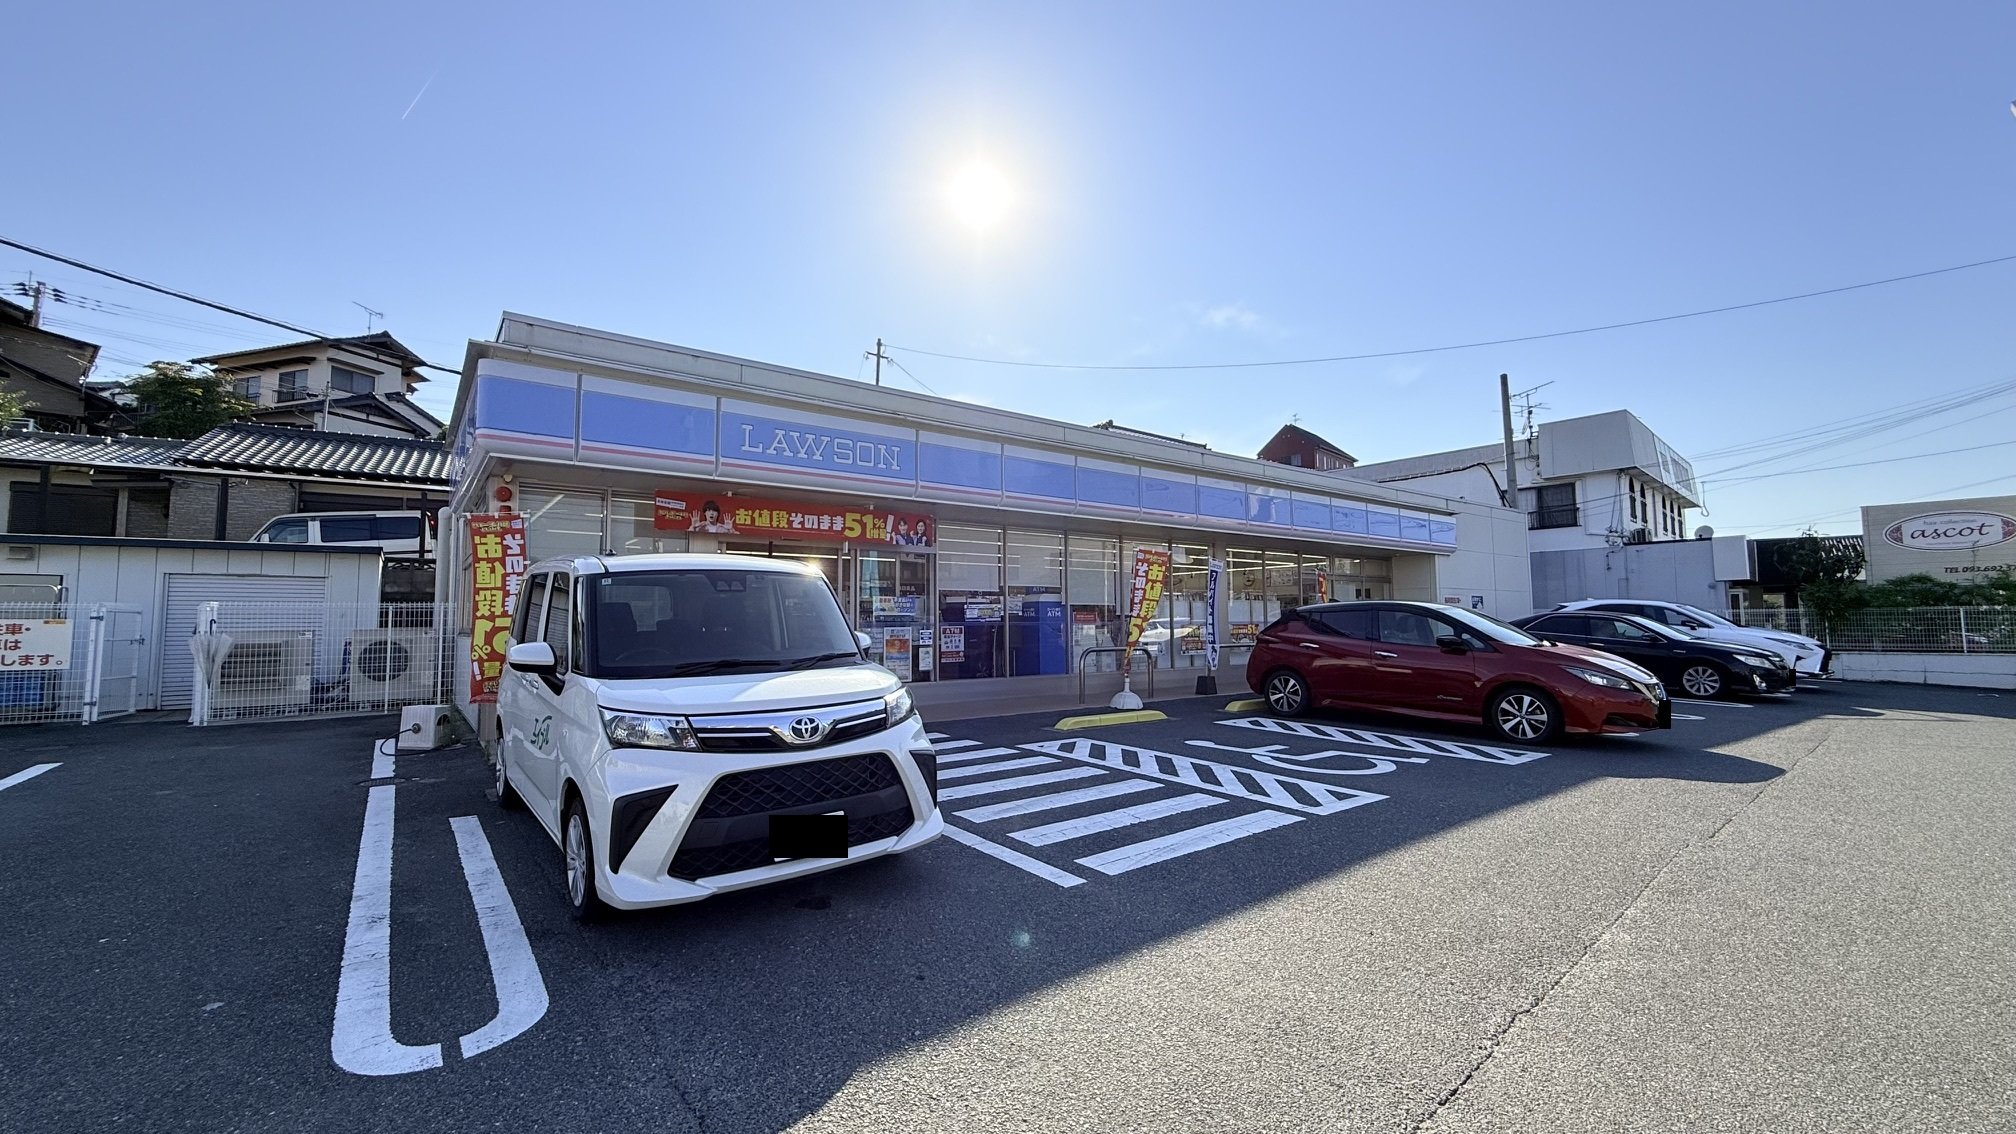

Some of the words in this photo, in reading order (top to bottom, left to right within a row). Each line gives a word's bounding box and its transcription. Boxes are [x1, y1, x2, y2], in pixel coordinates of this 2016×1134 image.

[741, 424, 901, 470] LAWSON
[1910, 522, 1994, 540] ascot
[1, 654, 63, 666] します。
